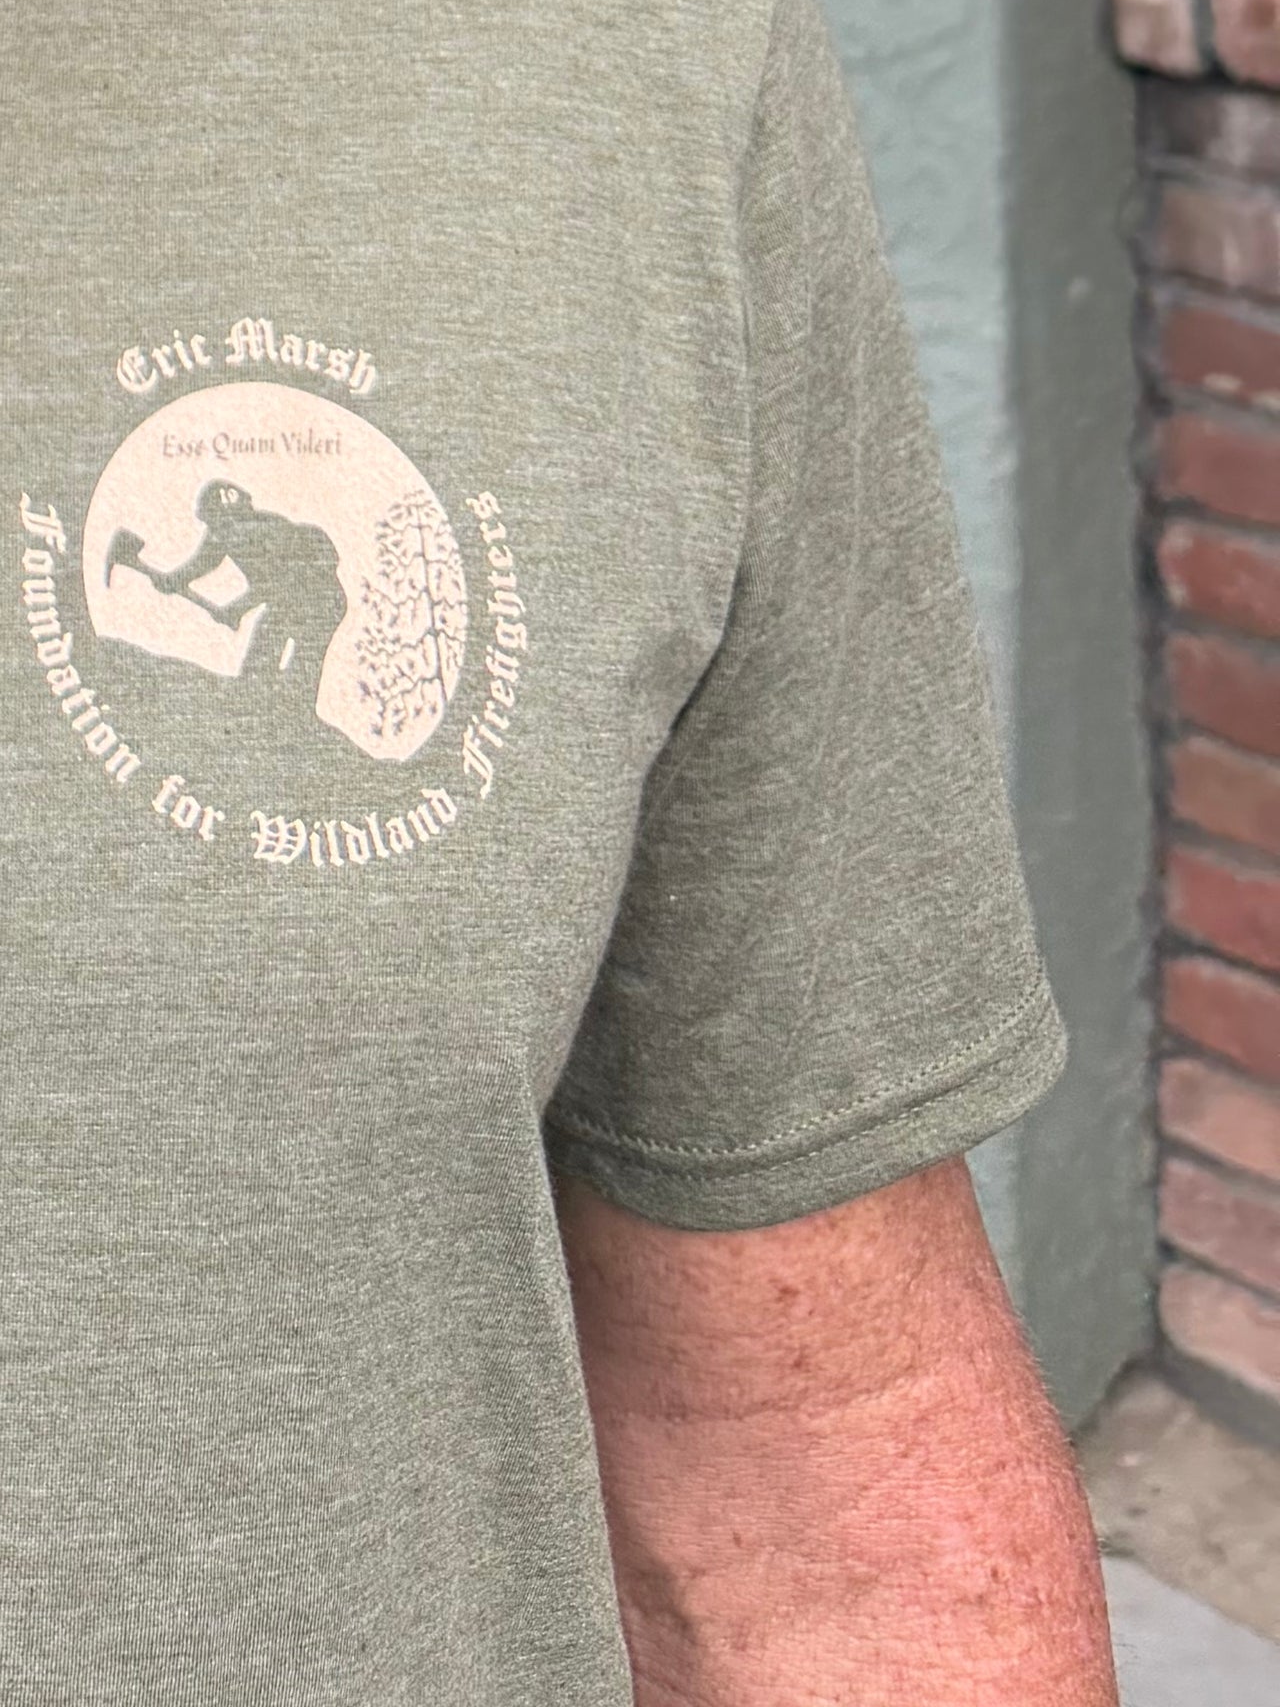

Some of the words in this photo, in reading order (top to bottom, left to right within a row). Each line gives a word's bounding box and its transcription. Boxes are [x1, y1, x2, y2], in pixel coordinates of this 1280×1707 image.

[116, 330, 211, 392] Eric
[225, 317, 376, 393] Marsh
[162, 433, 207, 459] Esse
[212, 432, 276, 461] Quam
[281, 428, 343, 455] Videri
[20, 492, 141, 782] Foundation
[152, 775, 224, 841] for
[250, 787, 458, 867] Wildland
[463, 491, 527, 799] Firefighters
